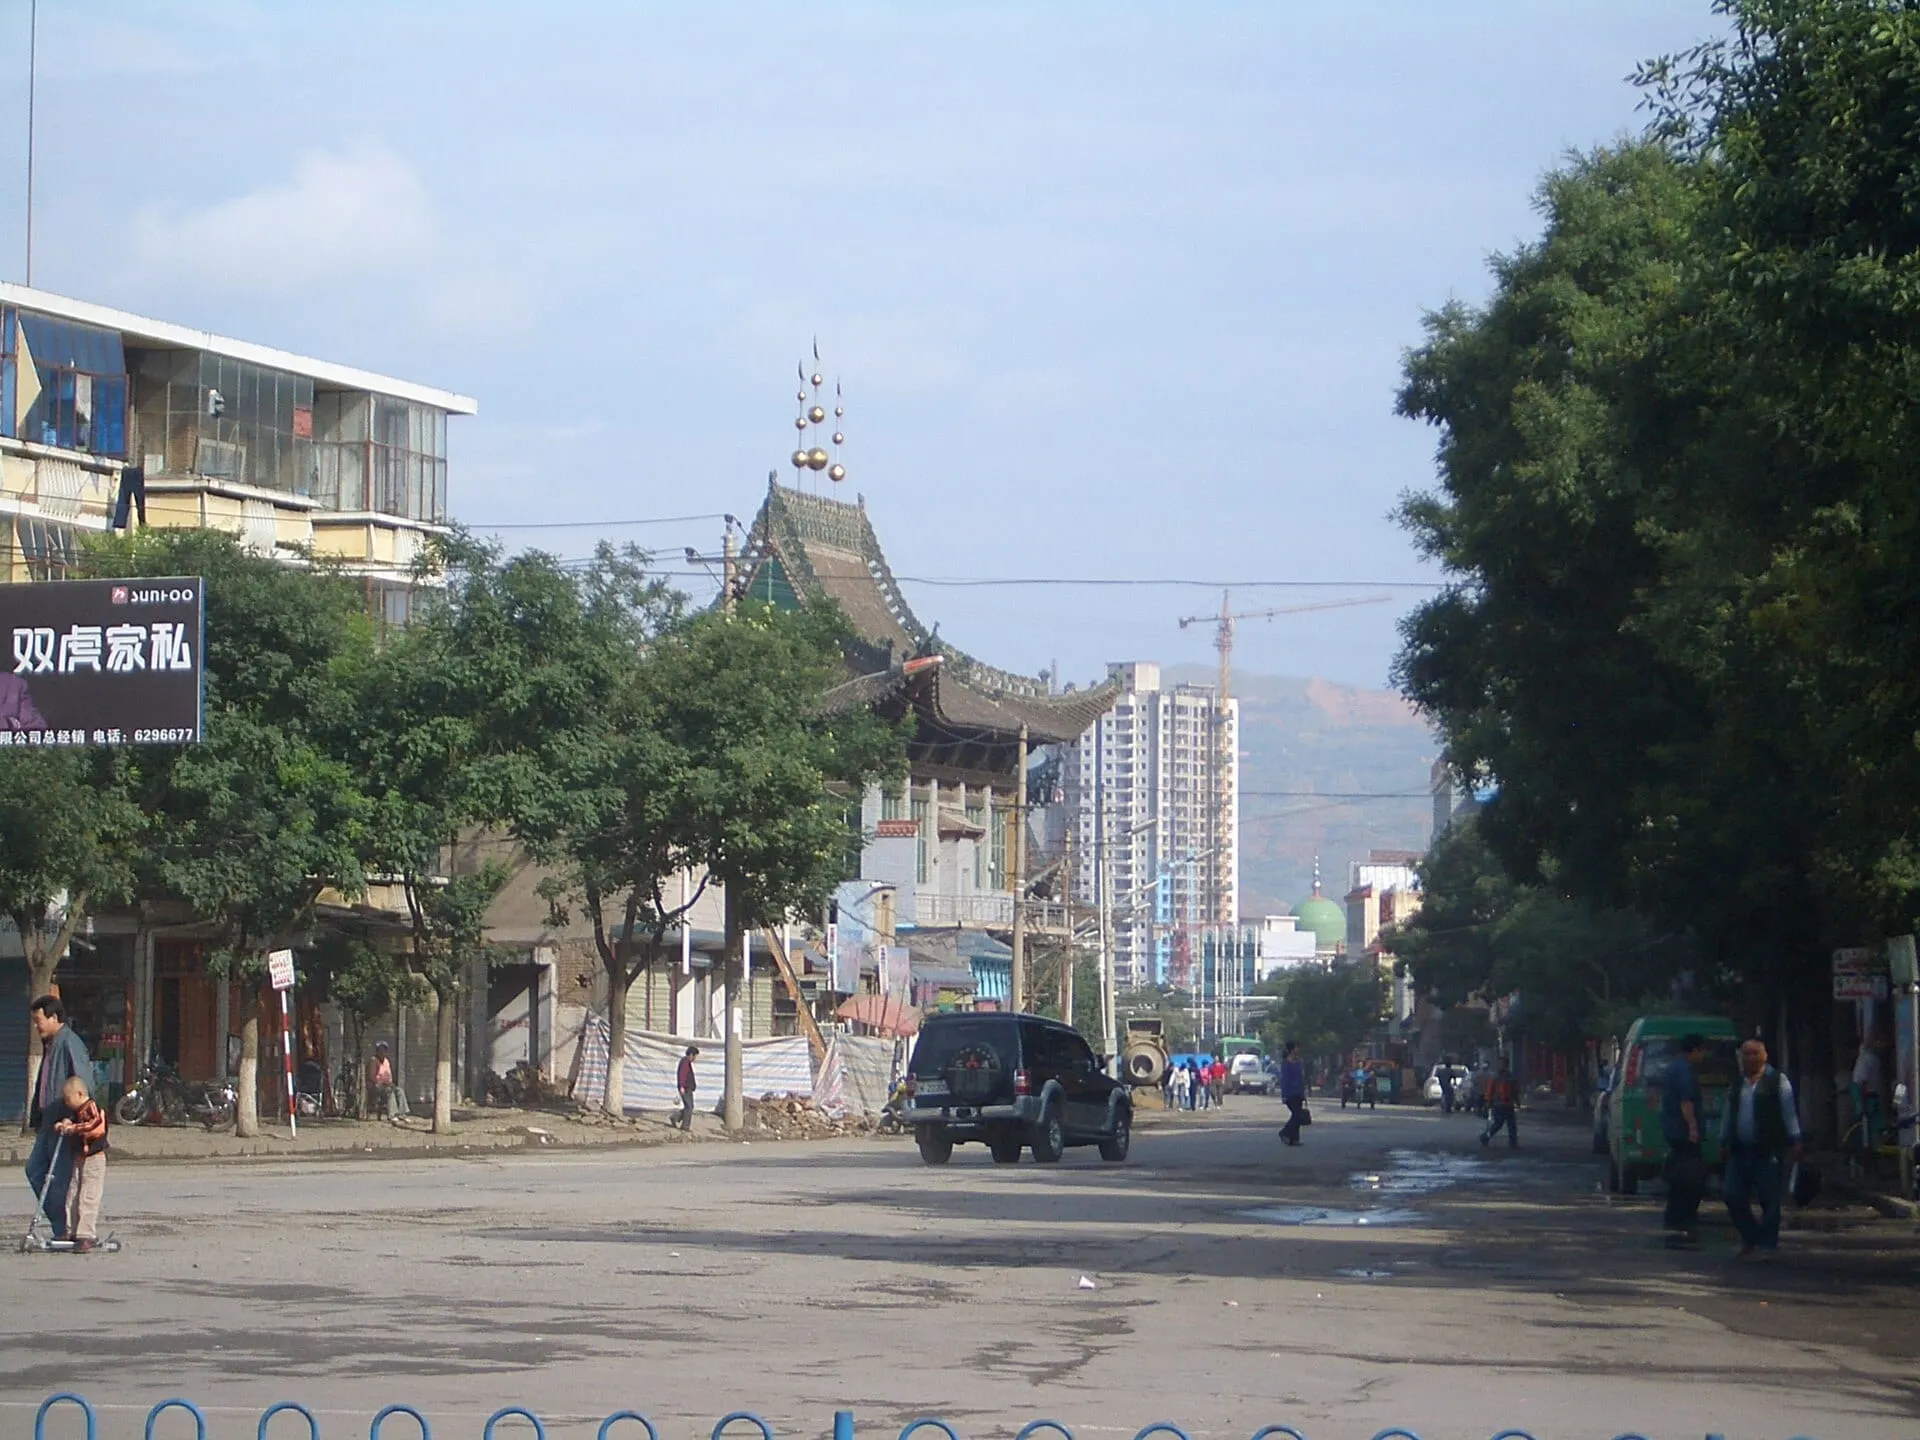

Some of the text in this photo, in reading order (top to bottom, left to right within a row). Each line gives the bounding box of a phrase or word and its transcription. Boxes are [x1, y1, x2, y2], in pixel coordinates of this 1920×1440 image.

[13, 623, 192, 673] 双虎家私
[134, 729, 193, 741] 6296677
